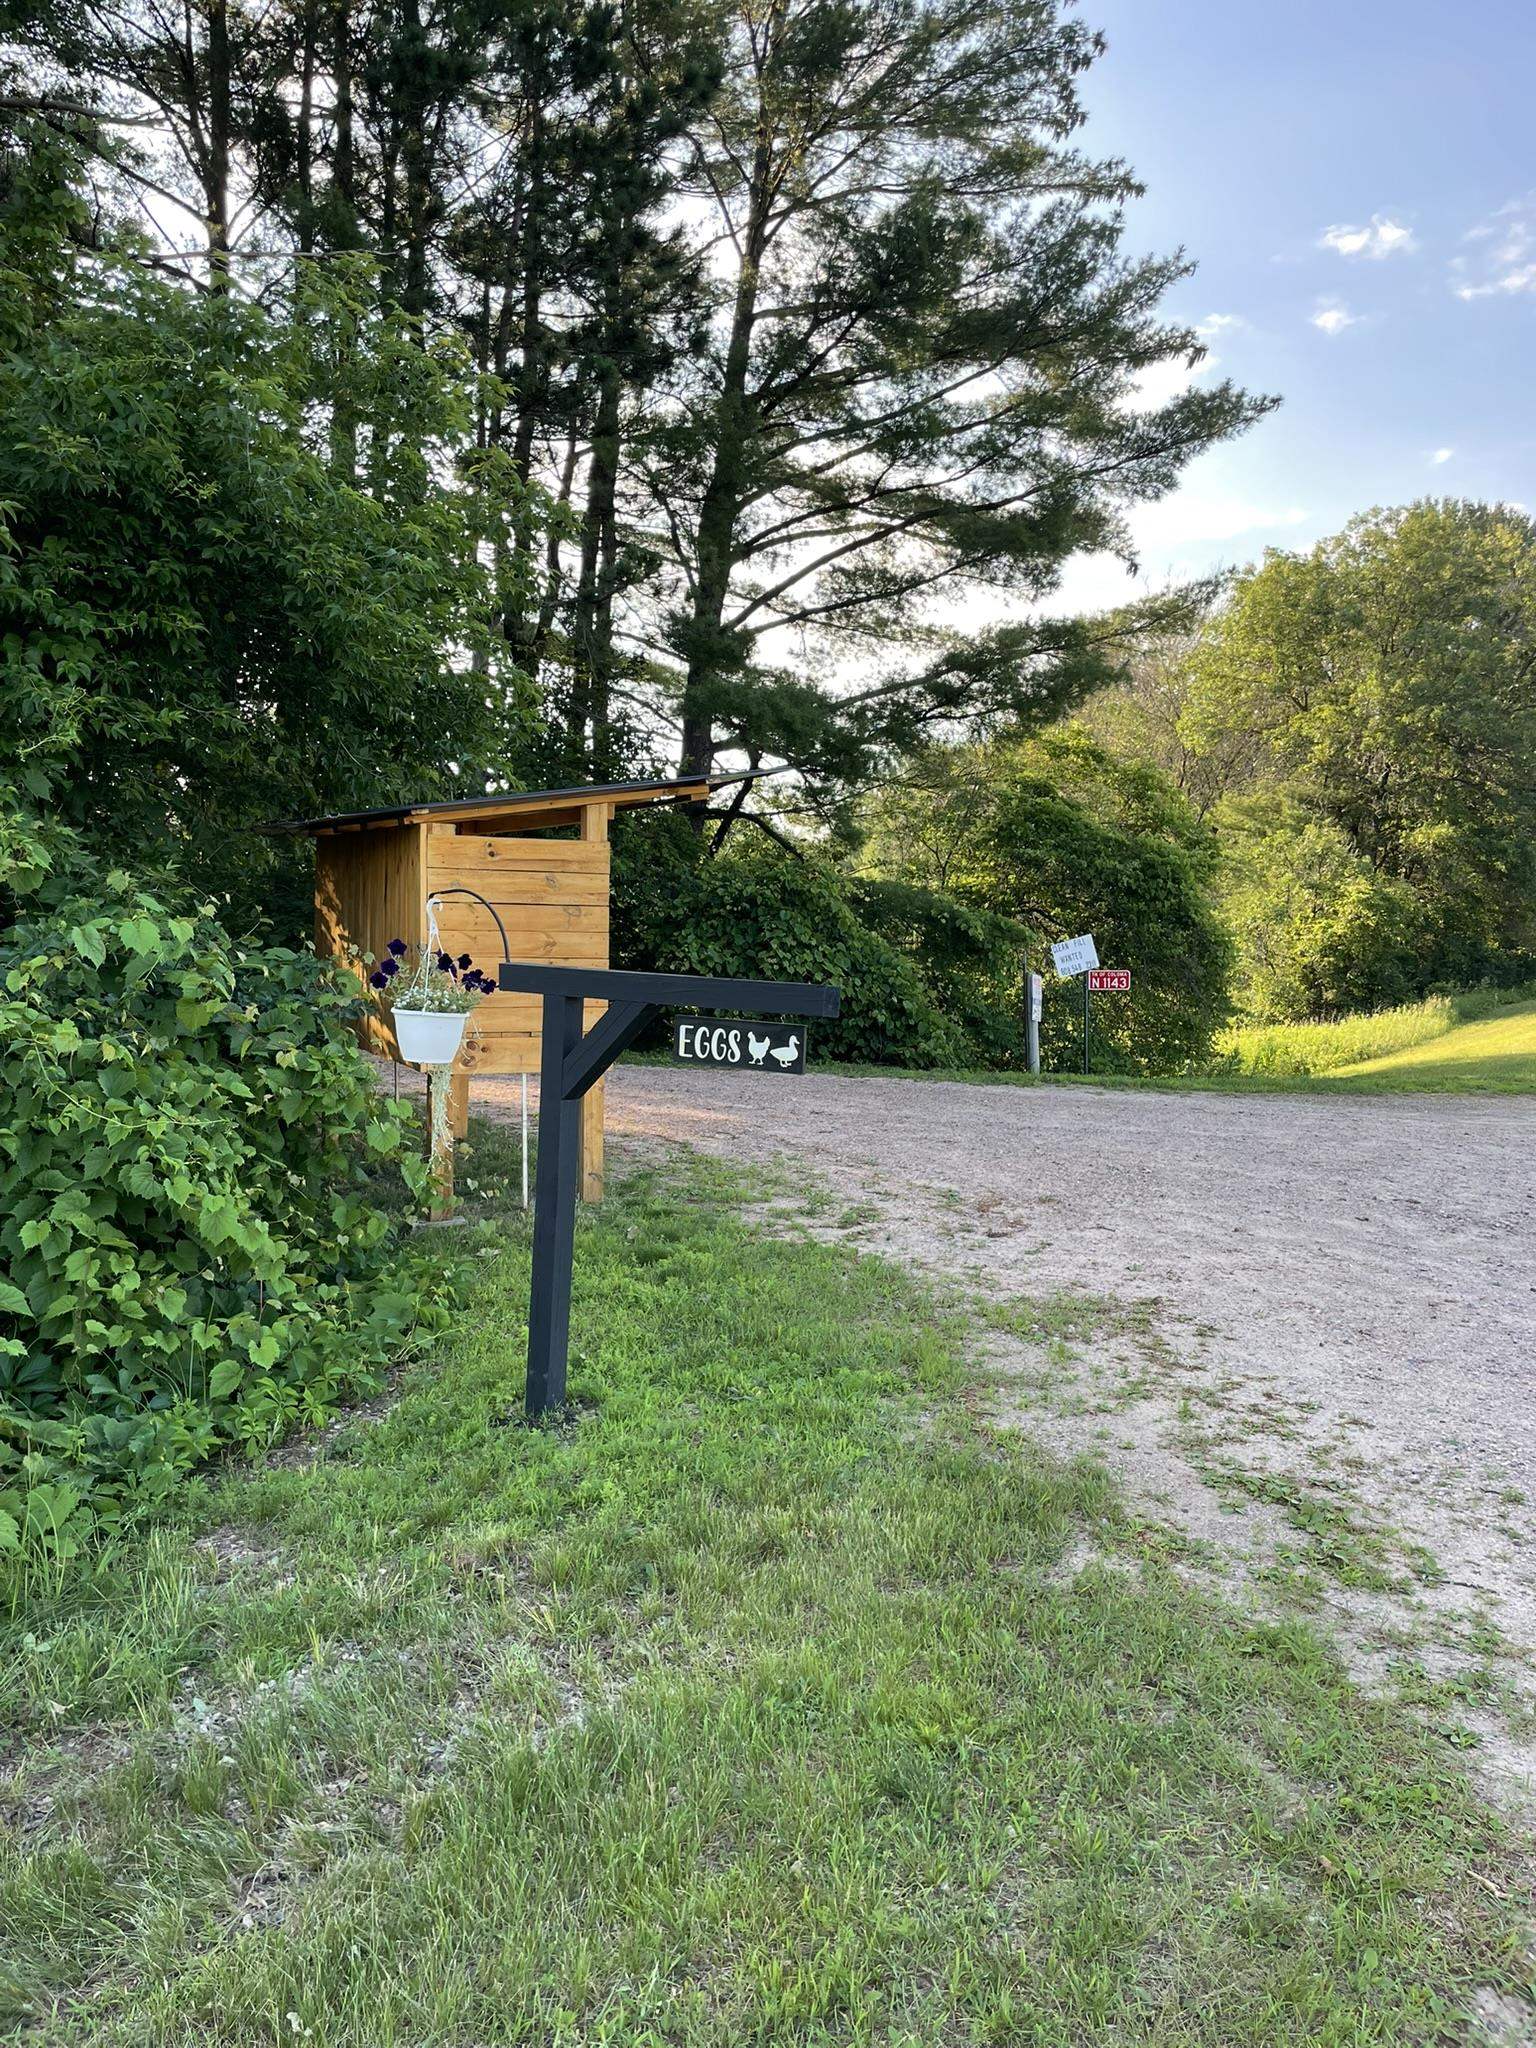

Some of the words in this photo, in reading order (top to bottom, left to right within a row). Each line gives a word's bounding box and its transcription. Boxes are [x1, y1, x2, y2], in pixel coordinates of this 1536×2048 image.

[1061, 951, 1082, 963] WANTED
[1092, 977, 1099, 988] N
[1103, 977, 1126, 988] 1143
[678, 1024, 740, 1062] EGGS
